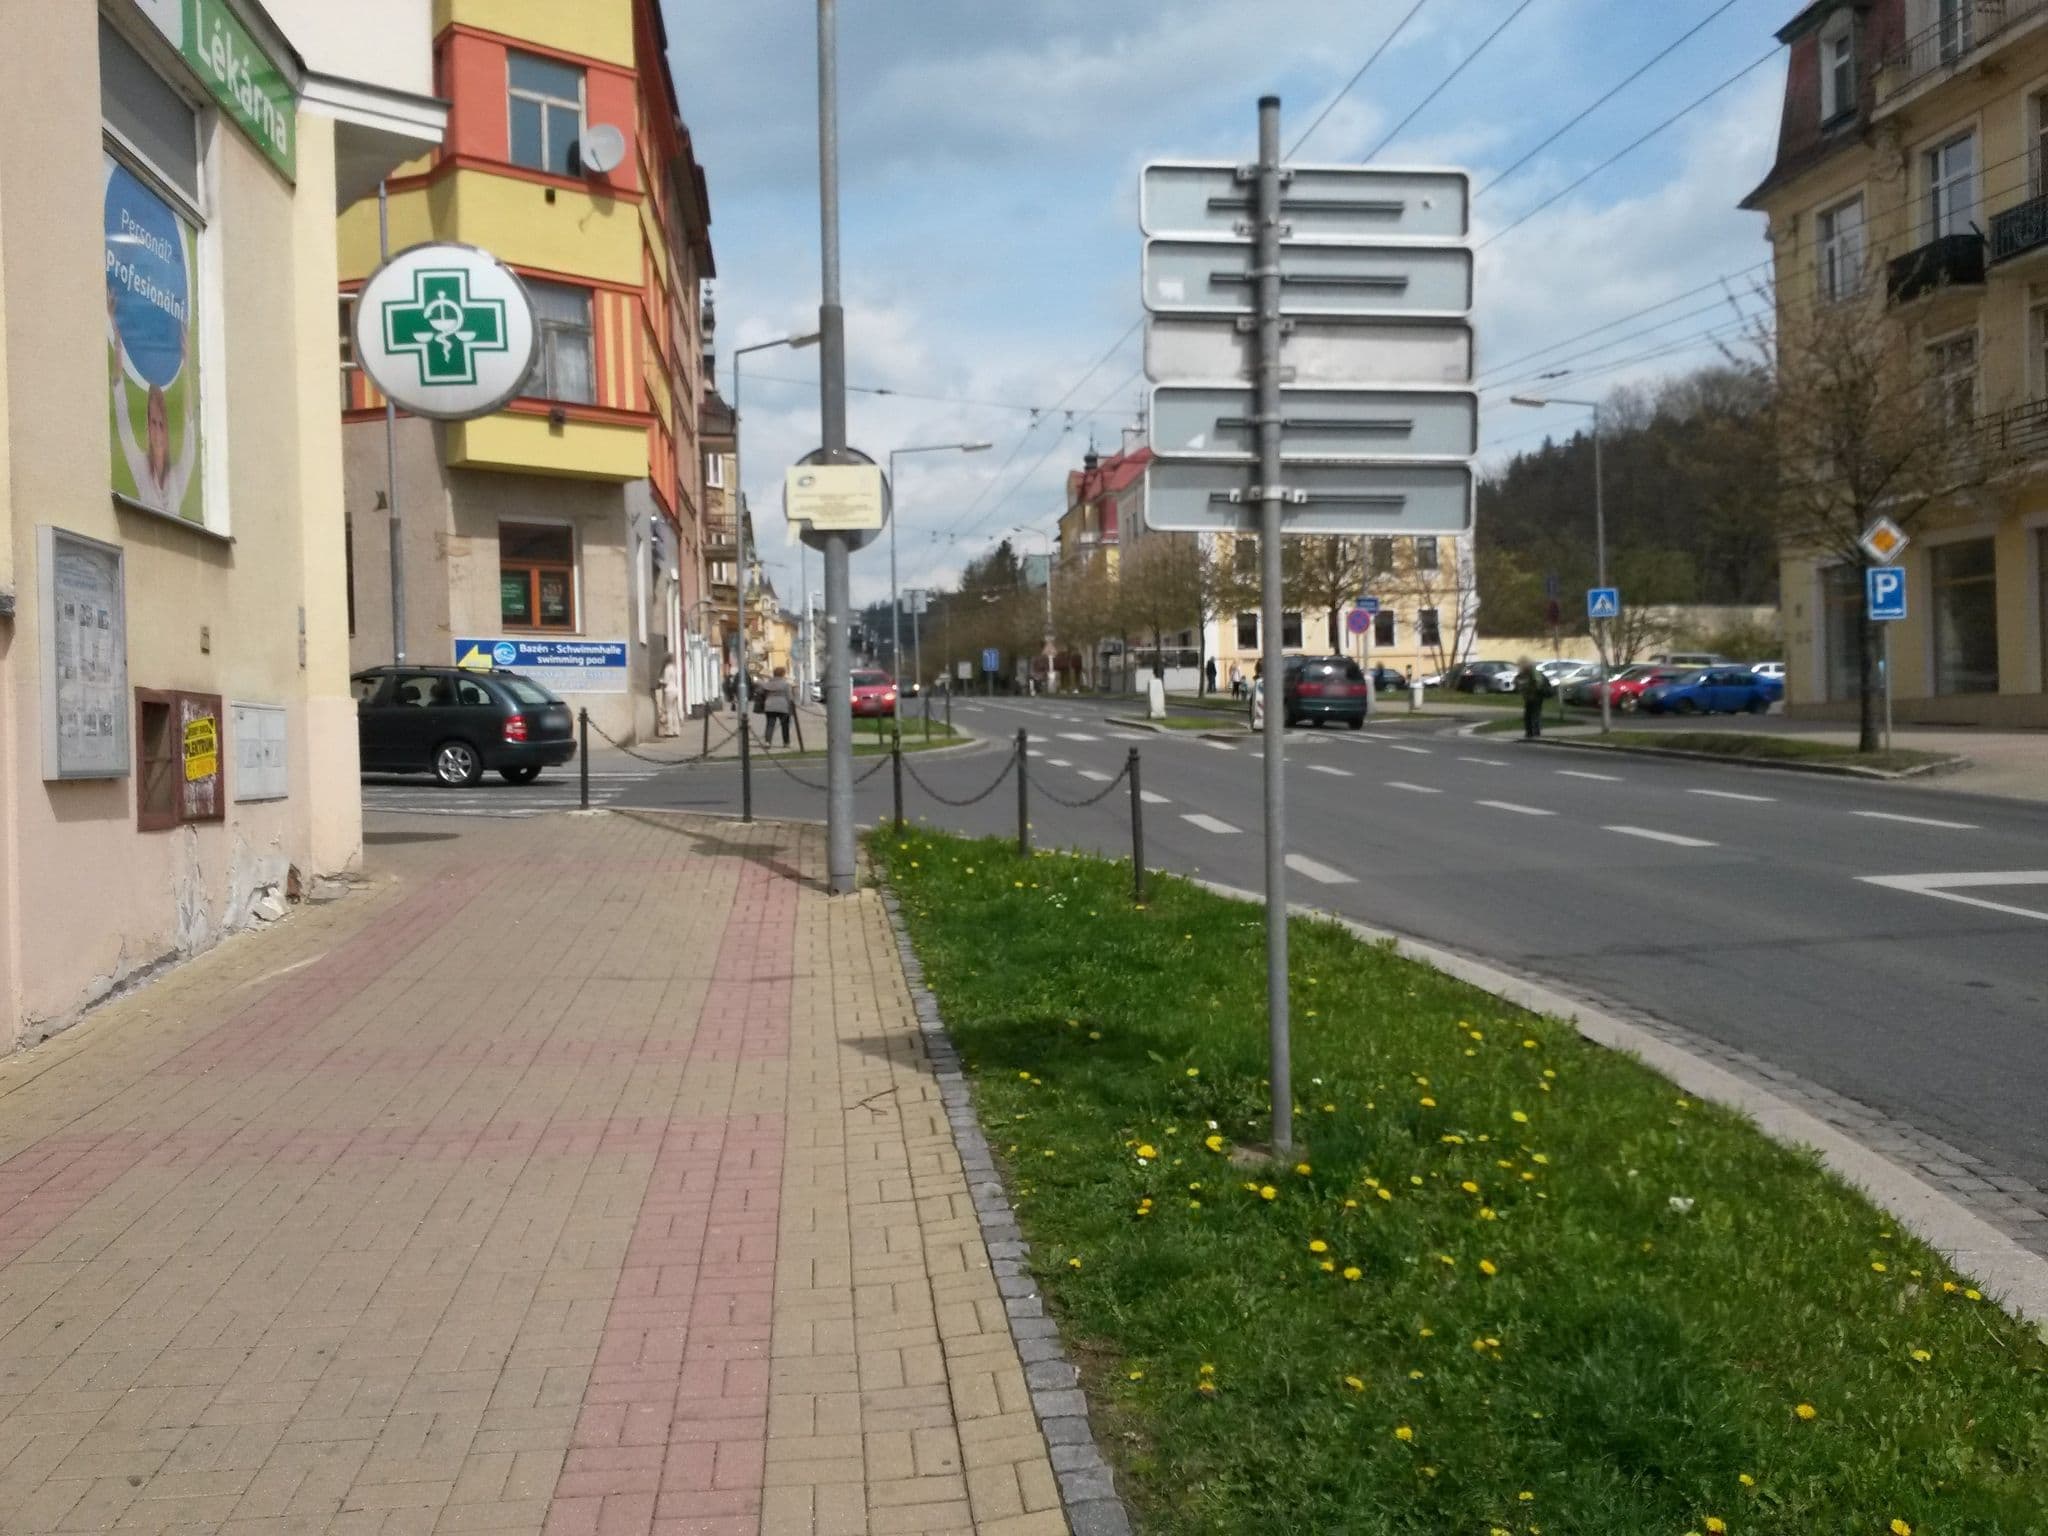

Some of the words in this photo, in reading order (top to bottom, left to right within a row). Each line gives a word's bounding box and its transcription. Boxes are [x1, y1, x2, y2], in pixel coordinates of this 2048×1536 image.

[196, 0, 287, 156] Lékárna
[121, 207, 173, 264] Personál?
[106, 248, 186, 320] Profesionální
[1876, 574, 1898, 604] P
[519, 643, 549, 654] Bazén
[556, 644, 622, 655] Schwimmhalle
[537, 655, 584, 666] swimming
[585, 655, 606, 666] pool
